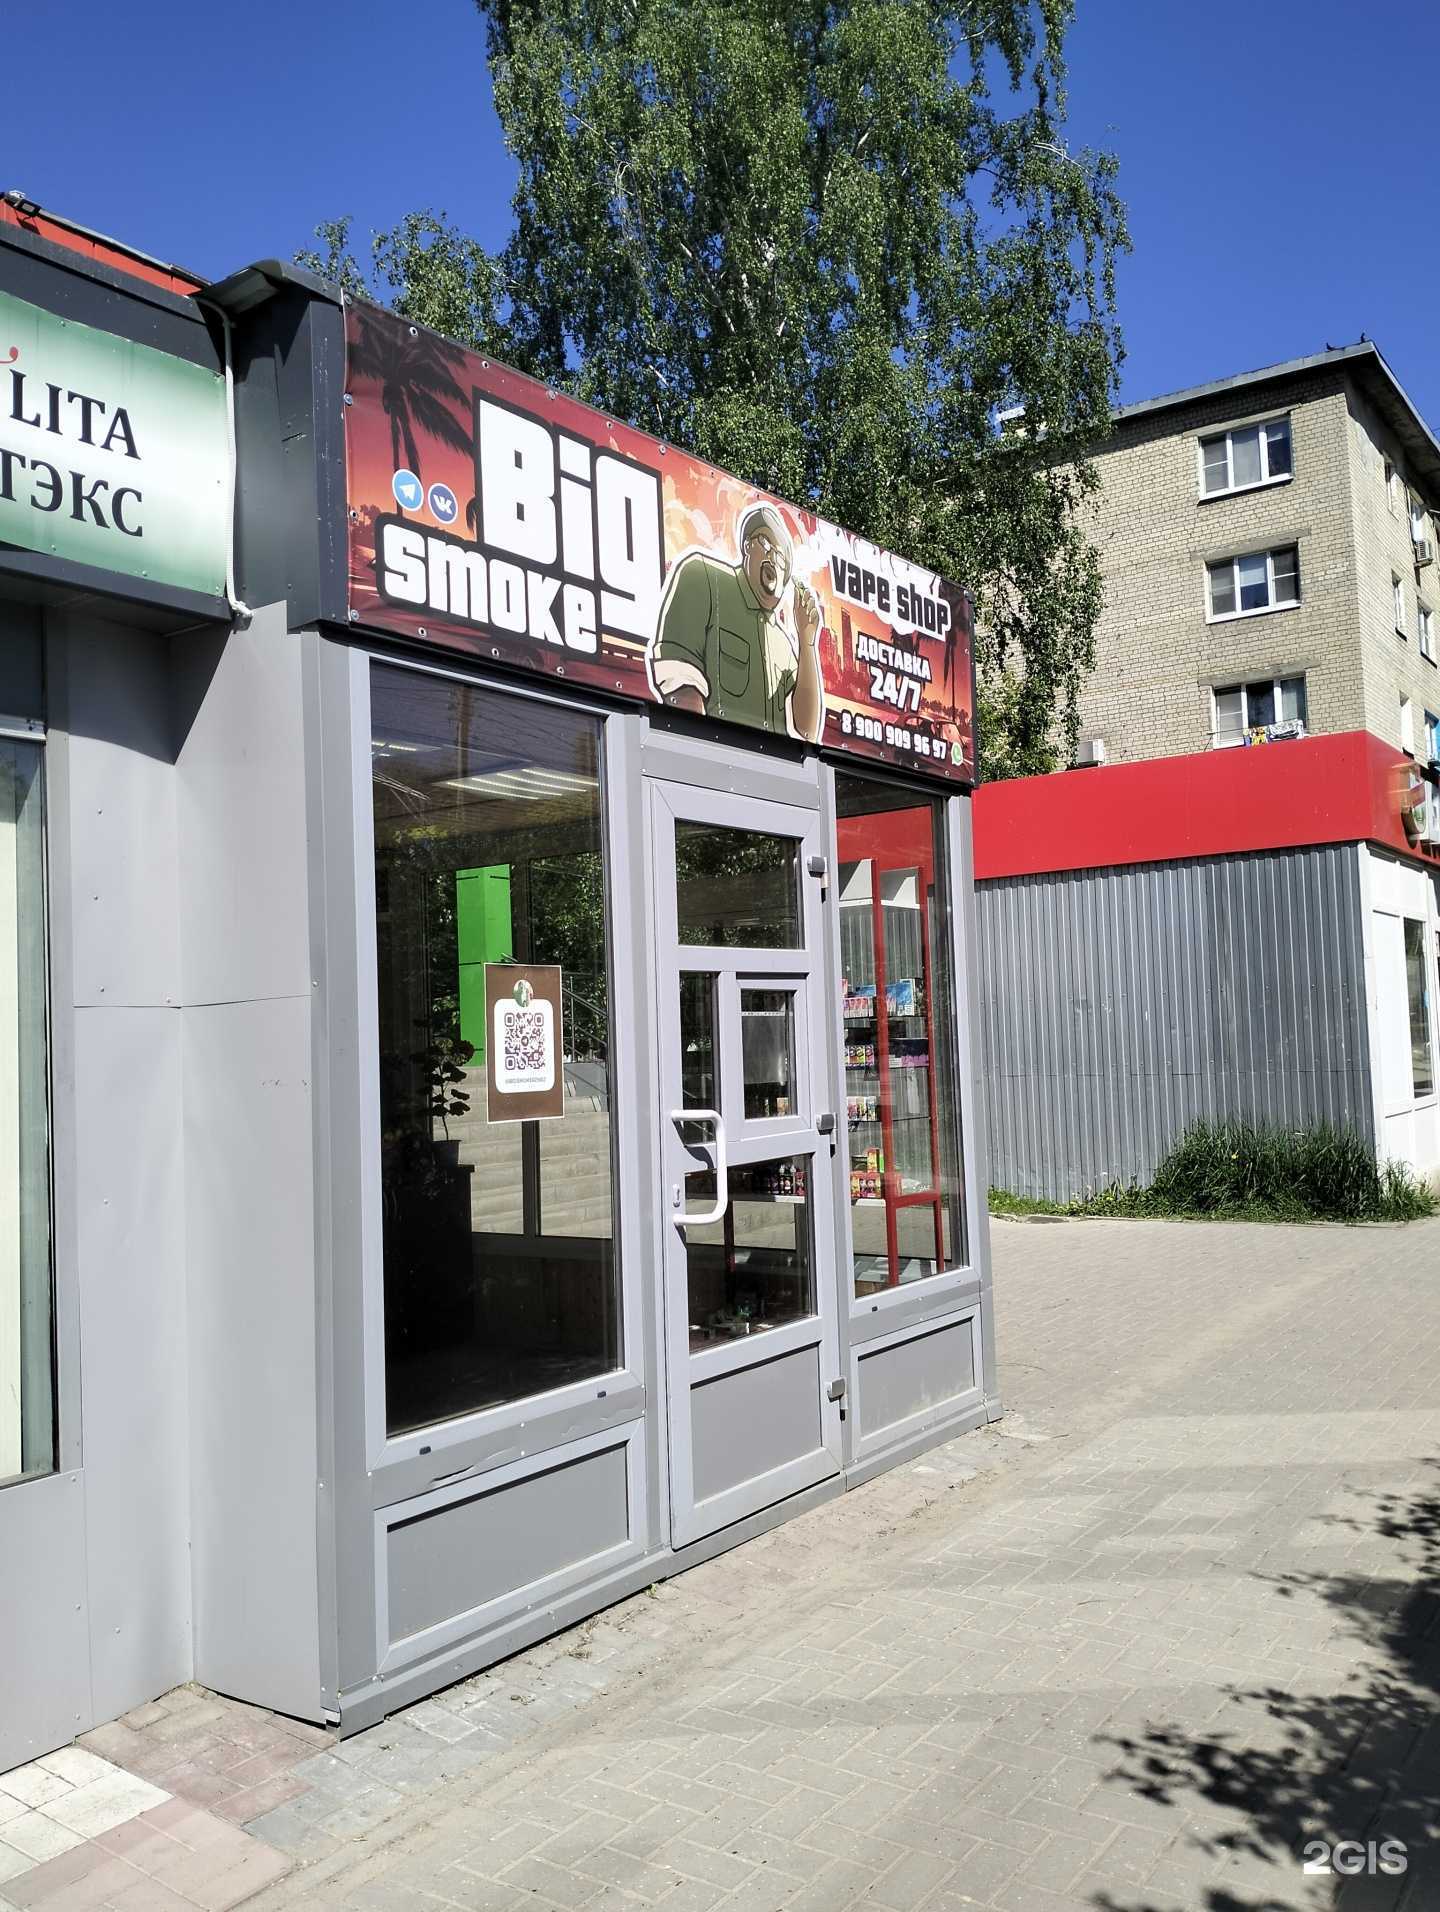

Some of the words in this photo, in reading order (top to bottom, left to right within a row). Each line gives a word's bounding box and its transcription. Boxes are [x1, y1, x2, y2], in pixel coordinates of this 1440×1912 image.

[9, 368, 142, 460] LITA
[0, 447, 143, 537] ТЭКС
[896, 584, 949, 635] shop
[870, 666, 922, 713] 24/7
[841, 712, 853, 734] 8
[855, 716, 882, 742] 900
[886, 725, 911, 750] 909
[913, 733, 931, 756] 96
[932, 739, 947, 760] 97
